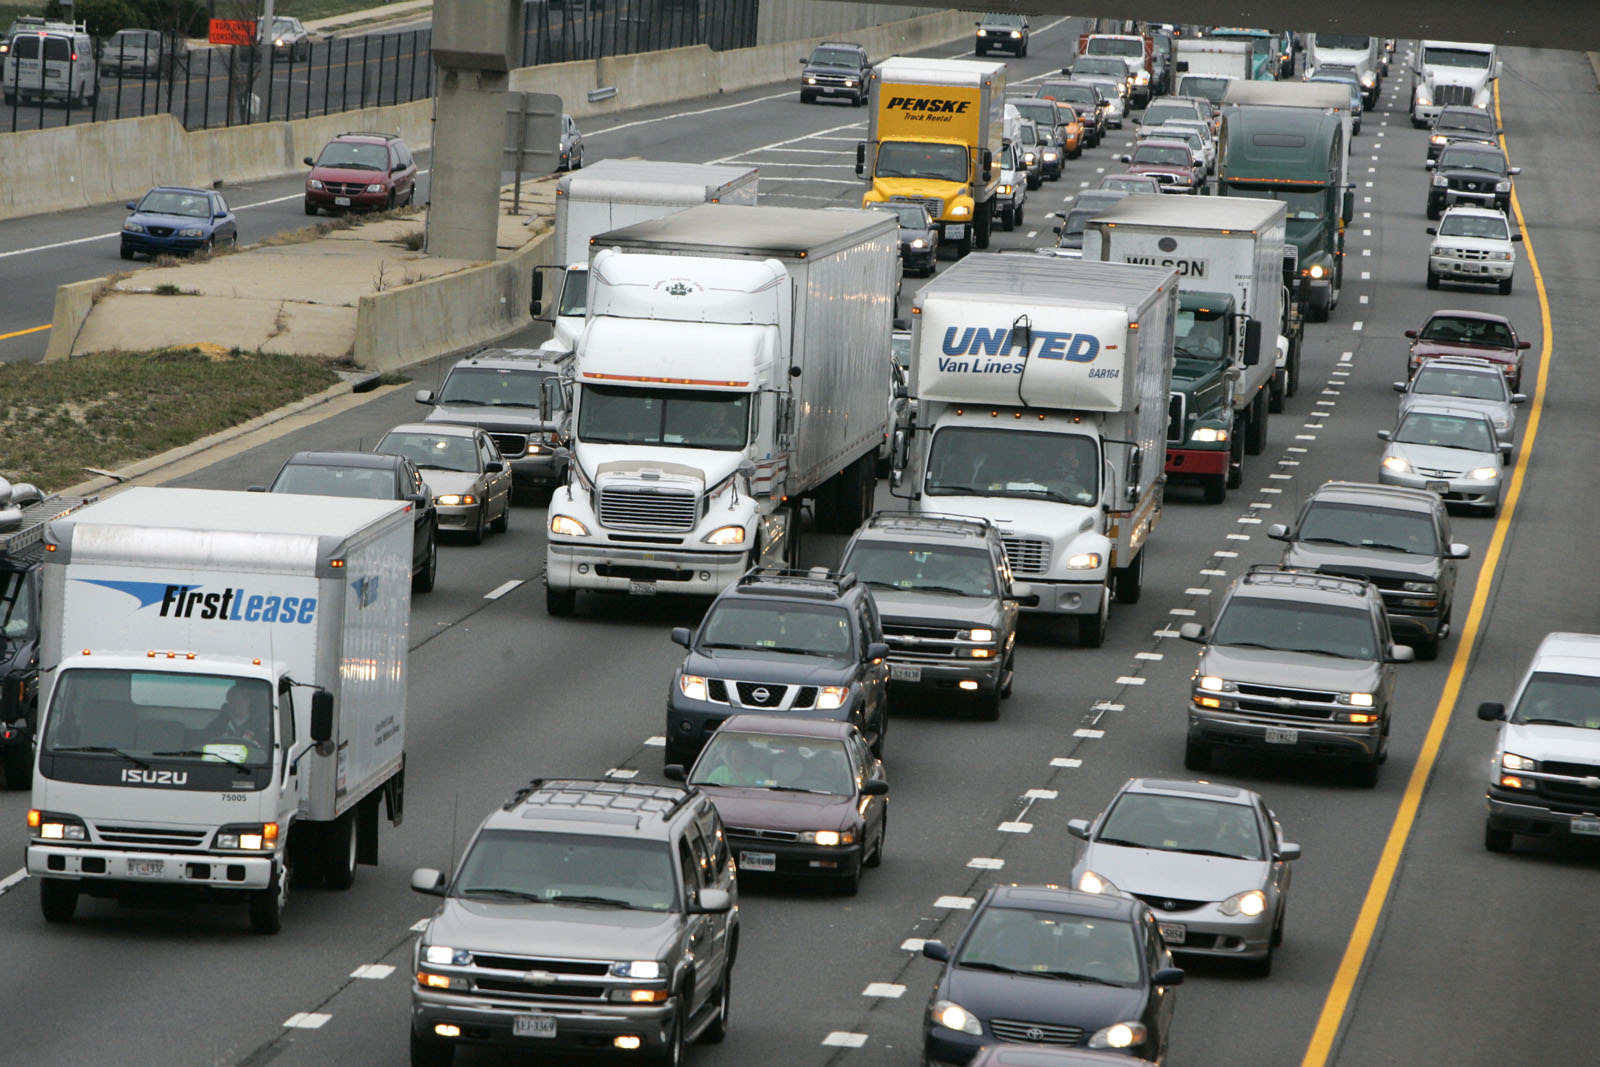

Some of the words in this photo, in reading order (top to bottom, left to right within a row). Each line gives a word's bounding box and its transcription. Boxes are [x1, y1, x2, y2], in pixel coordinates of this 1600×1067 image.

[887, 97, 971, 113] PENSKE
[904, 113, 923, 121] Truck
[926, 114, 952, 122] Rental
[942, 327, 1100, 363] UNITED
[938, 358, 968, 374] Van
[972, 358, 1024, 375] Lines
[1088, 368, 1120, 379] 8AR164
[159, 585, 317, 625] FirstLease
[121, 769, 188, 785] ISUZU
[222, 794, 247, 803] 75005
